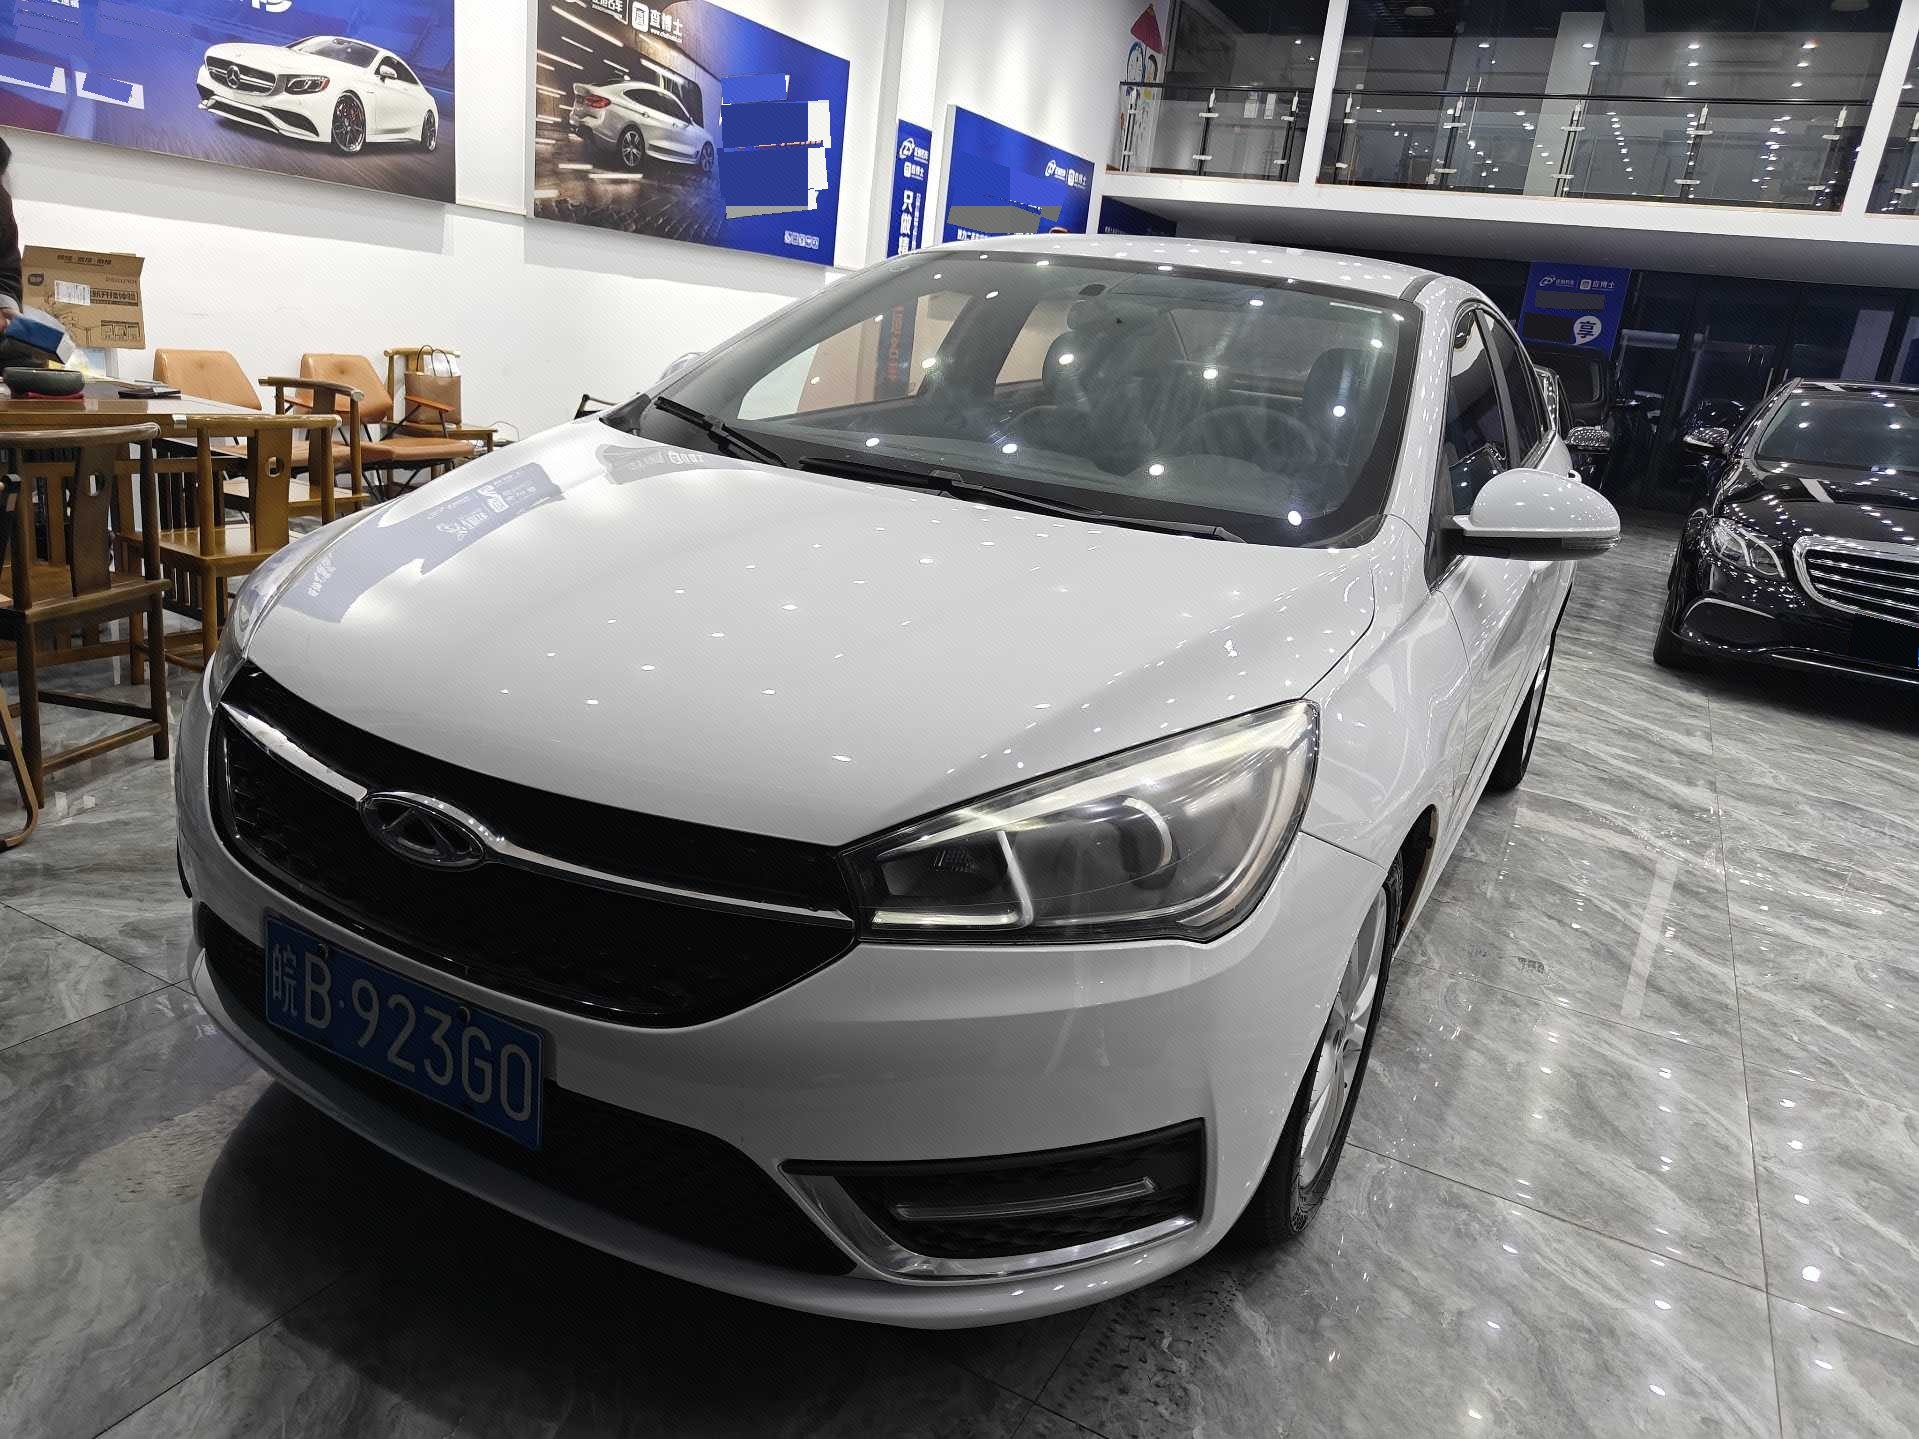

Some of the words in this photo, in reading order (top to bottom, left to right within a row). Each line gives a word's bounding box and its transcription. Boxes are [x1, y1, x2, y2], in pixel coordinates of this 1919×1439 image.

[650, 9, 683, 36] 查博士
[1577, 320, 1598, 339] 享
